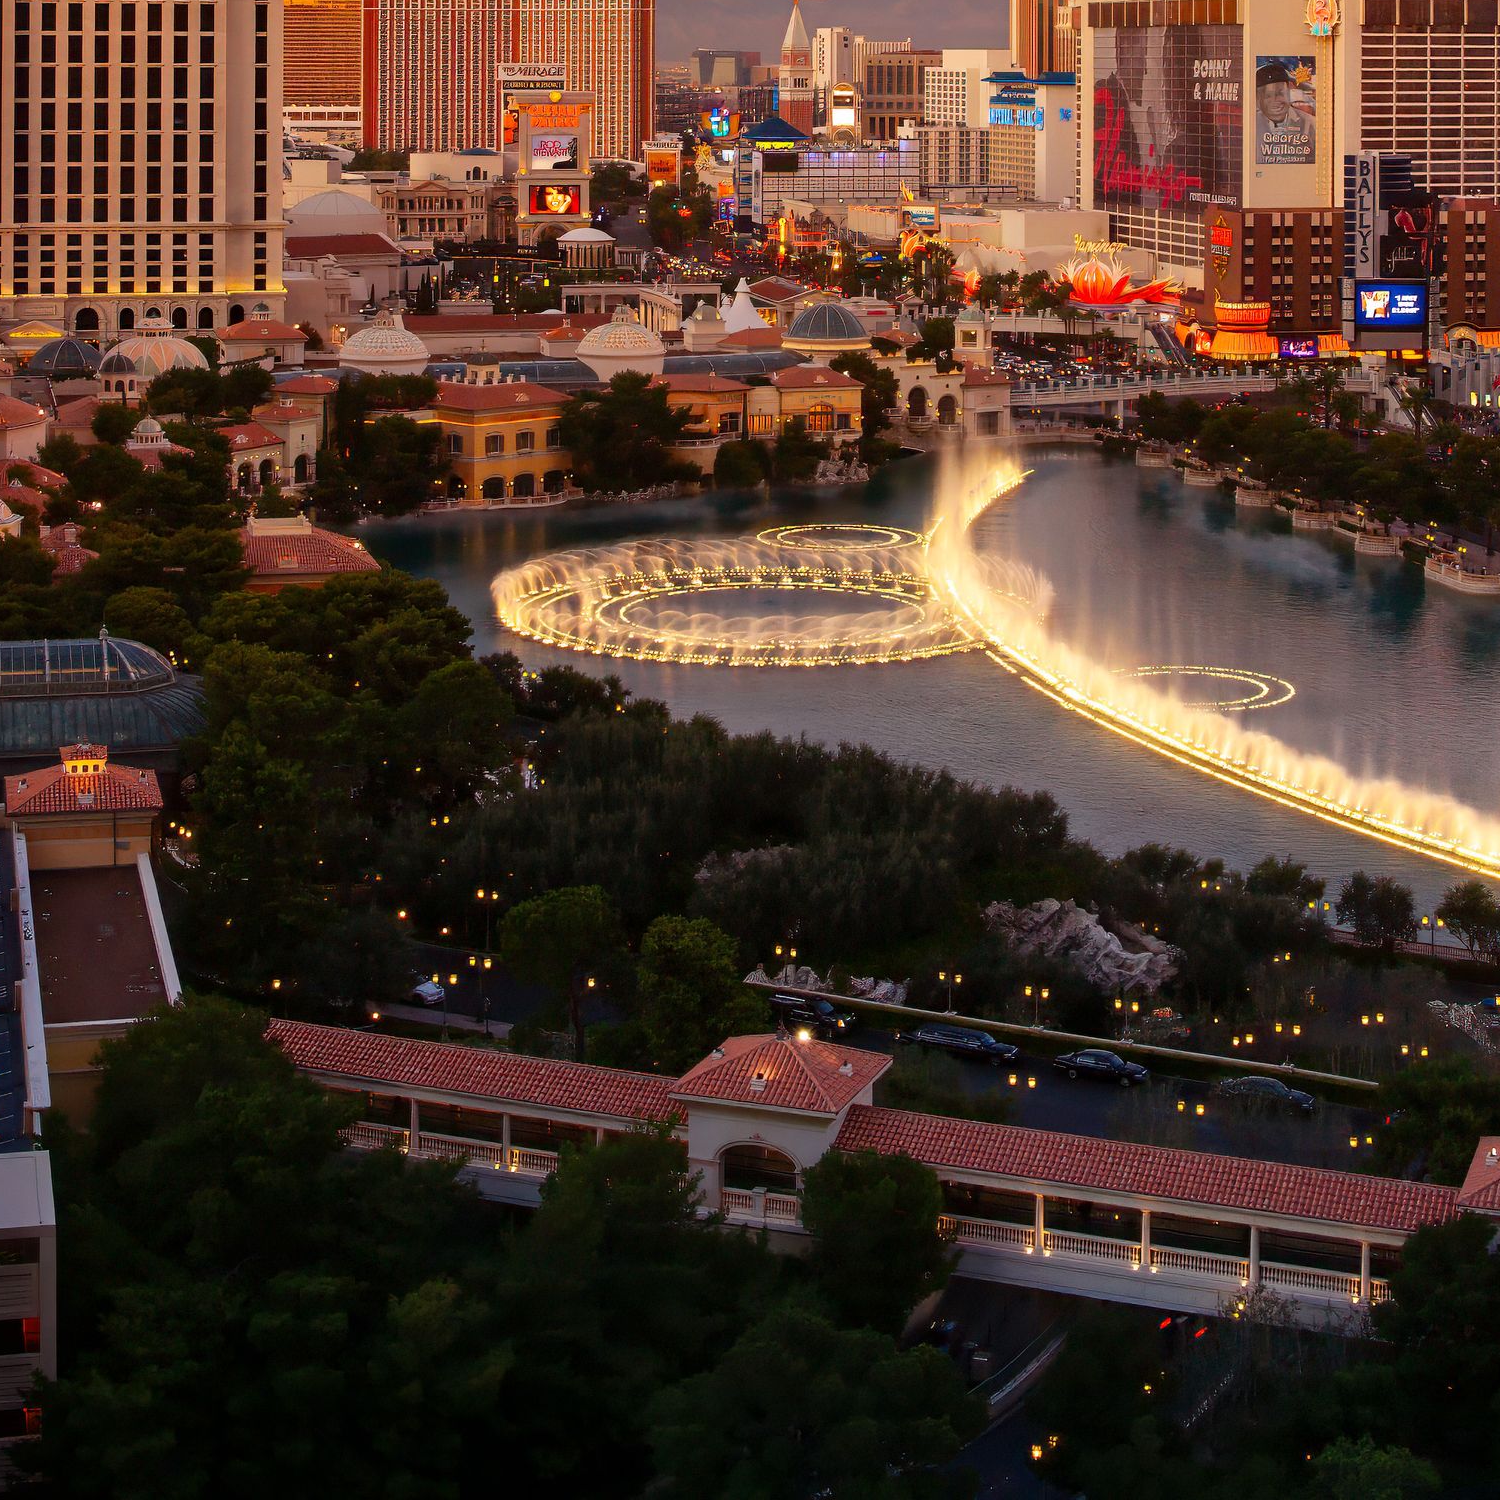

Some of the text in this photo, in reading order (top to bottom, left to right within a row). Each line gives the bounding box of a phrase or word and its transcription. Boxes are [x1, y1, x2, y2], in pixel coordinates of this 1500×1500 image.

[506, 66, 566, 77] MIRAGE
[1193, 82, 1202, 100] &
[541, 140, 562, 149] ROD
